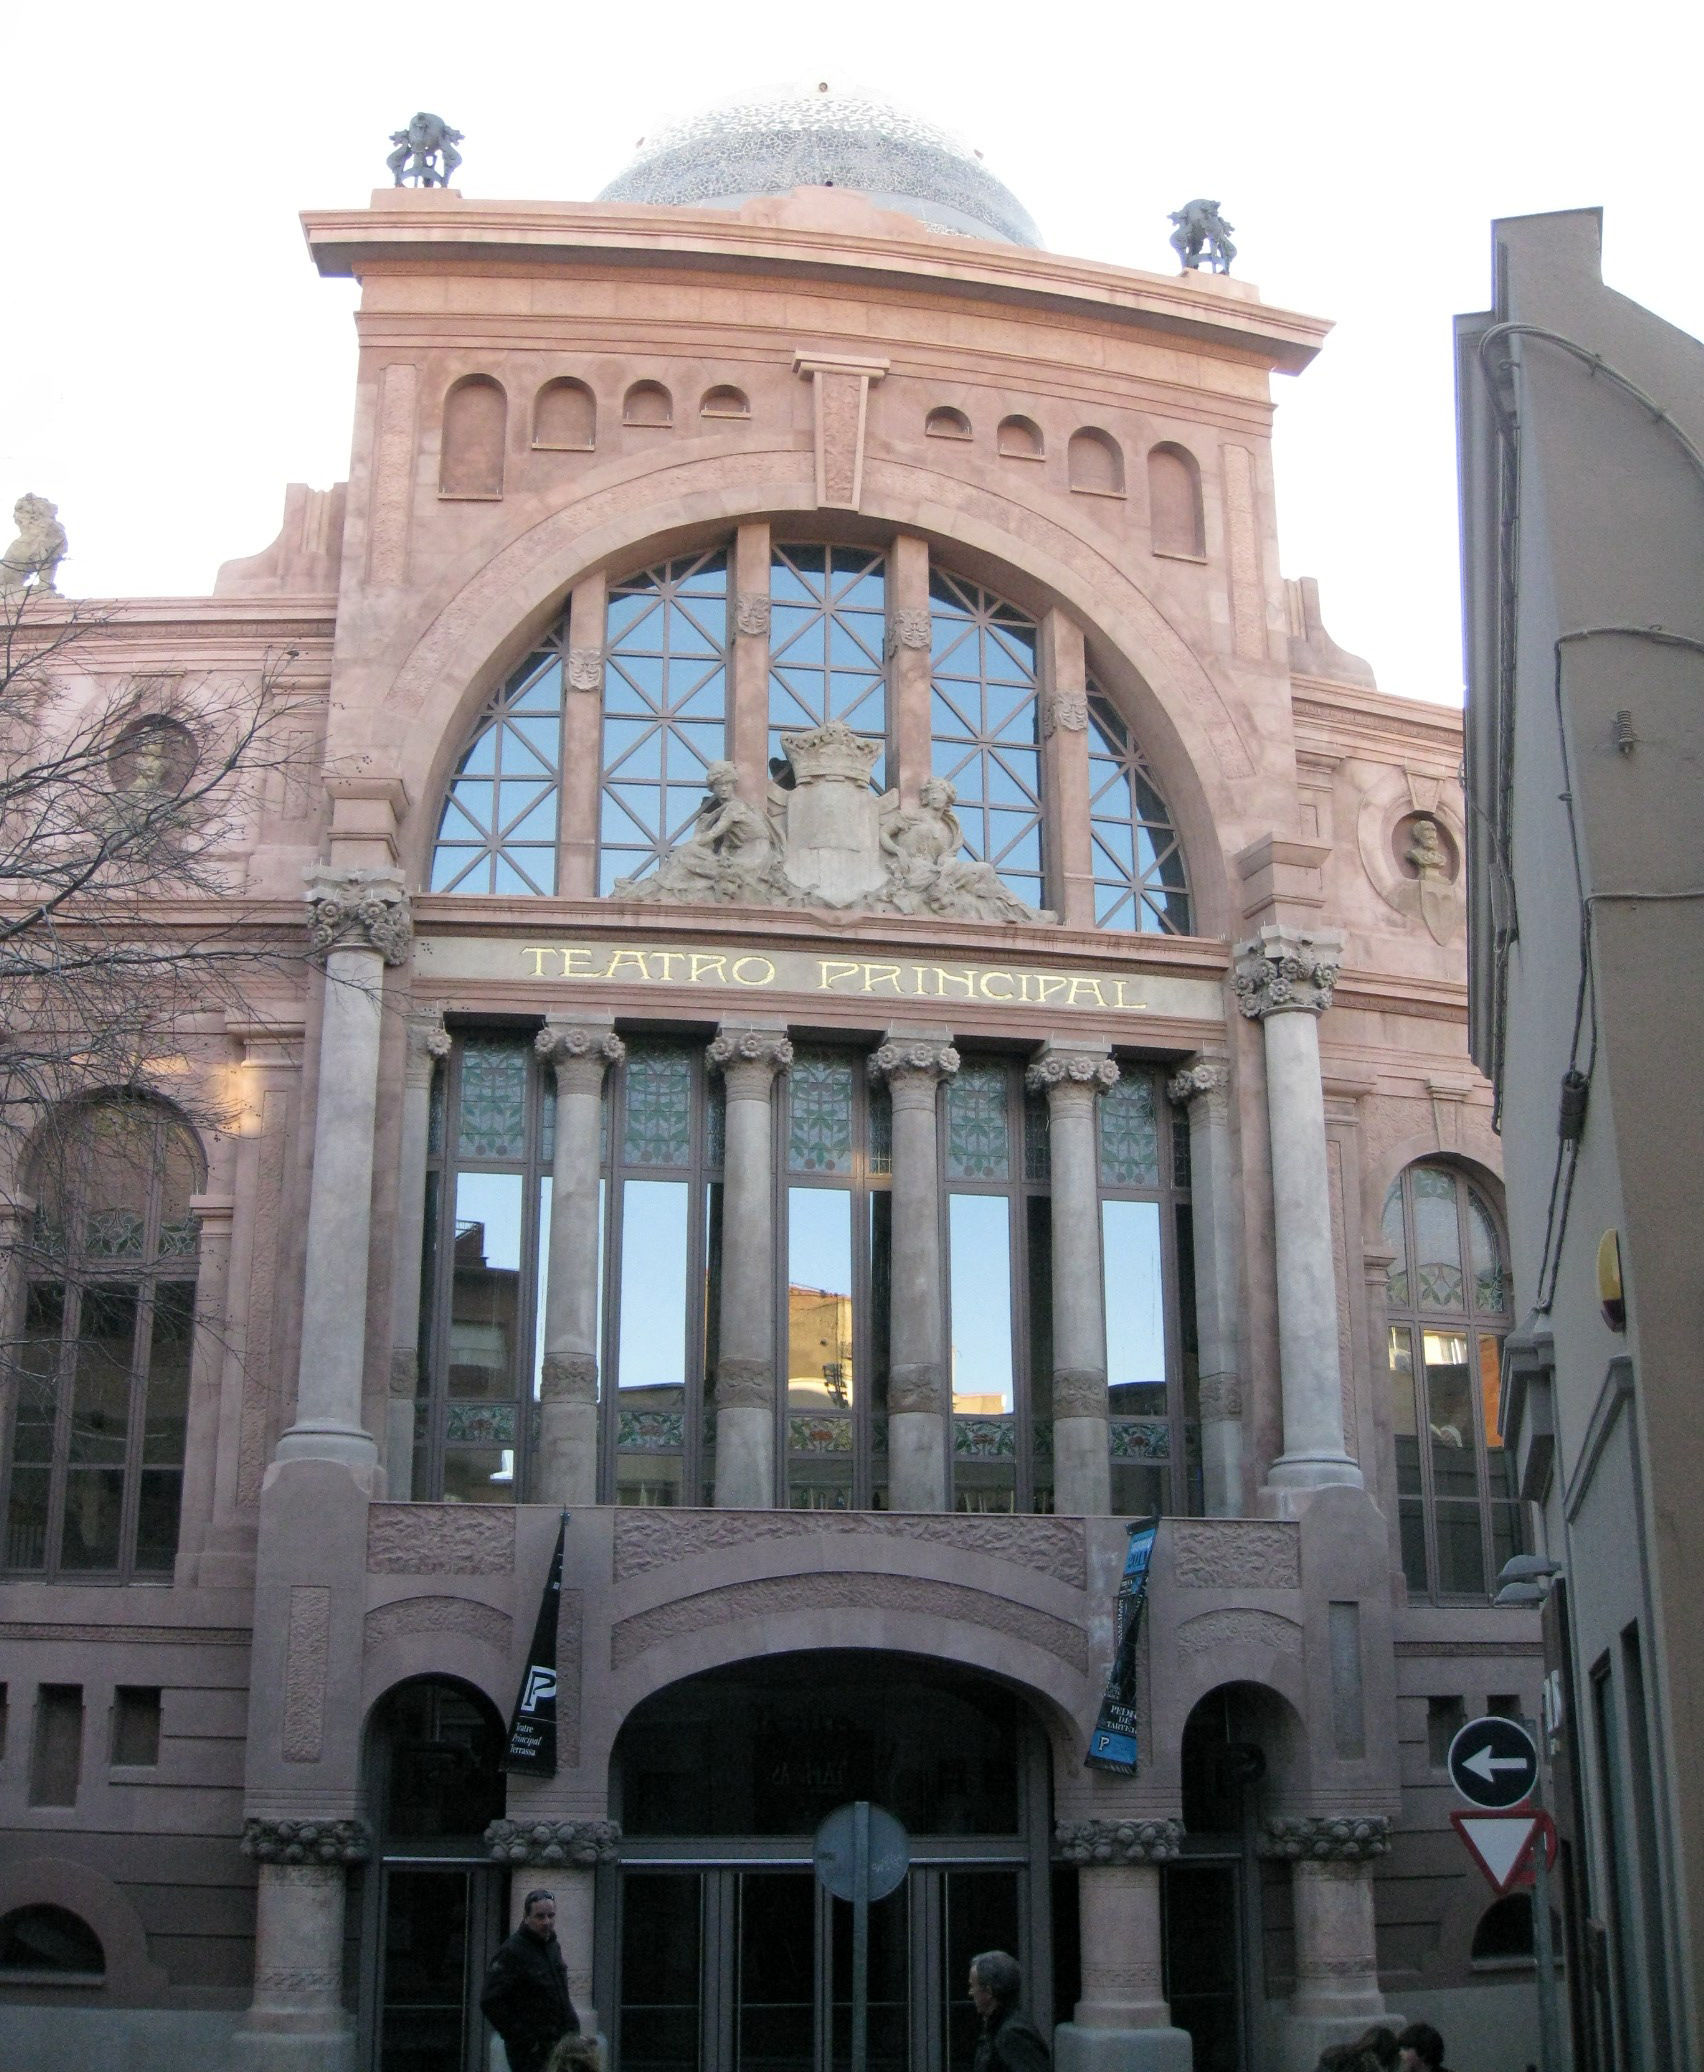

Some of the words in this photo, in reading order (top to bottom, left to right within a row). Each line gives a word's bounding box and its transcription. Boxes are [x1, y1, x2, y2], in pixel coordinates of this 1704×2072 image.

[521, 947, 776, 986] TEATRO
[817, 960, 1148, 1010] PRINCIPAL
[521, 1665, 557, 1711] P
[510, 1744, 536, 1756] Terrassa
[511, 1733, 542, 1747] Principal
